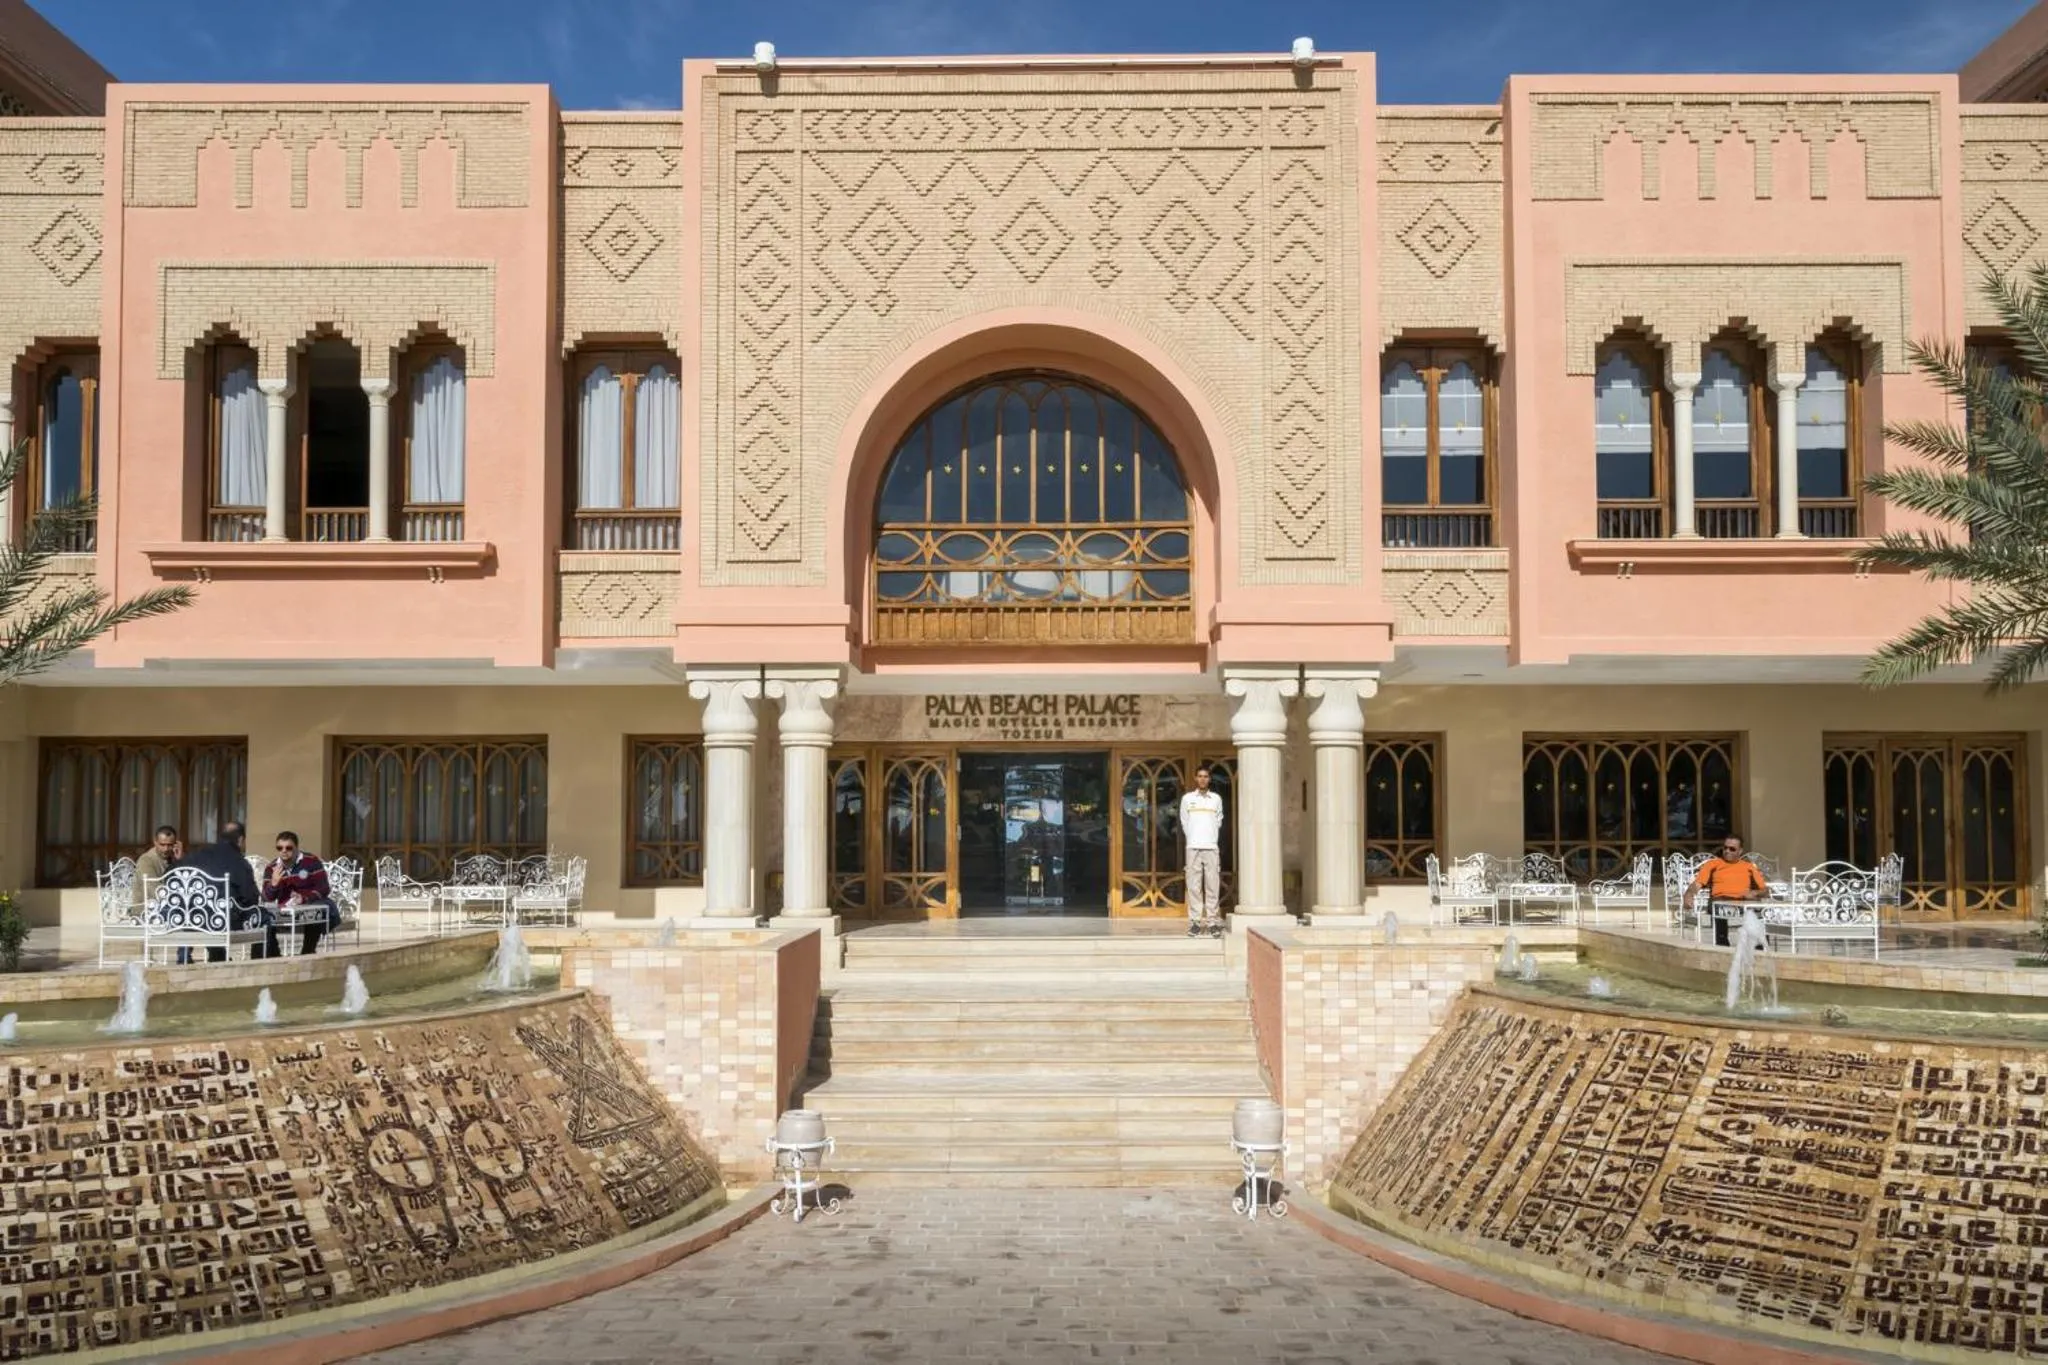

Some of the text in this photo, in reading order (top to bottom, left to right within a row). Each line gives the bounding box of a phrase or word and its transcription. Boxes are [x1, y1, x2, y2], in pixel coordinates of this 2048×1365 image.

[925, 694, 1141, 716] PALM BEACH PALACE
[929, 717, 1138, 728] MAGIC HOTELS & RESORTS
[1001, 729, 1064, 739] TOZEUR
